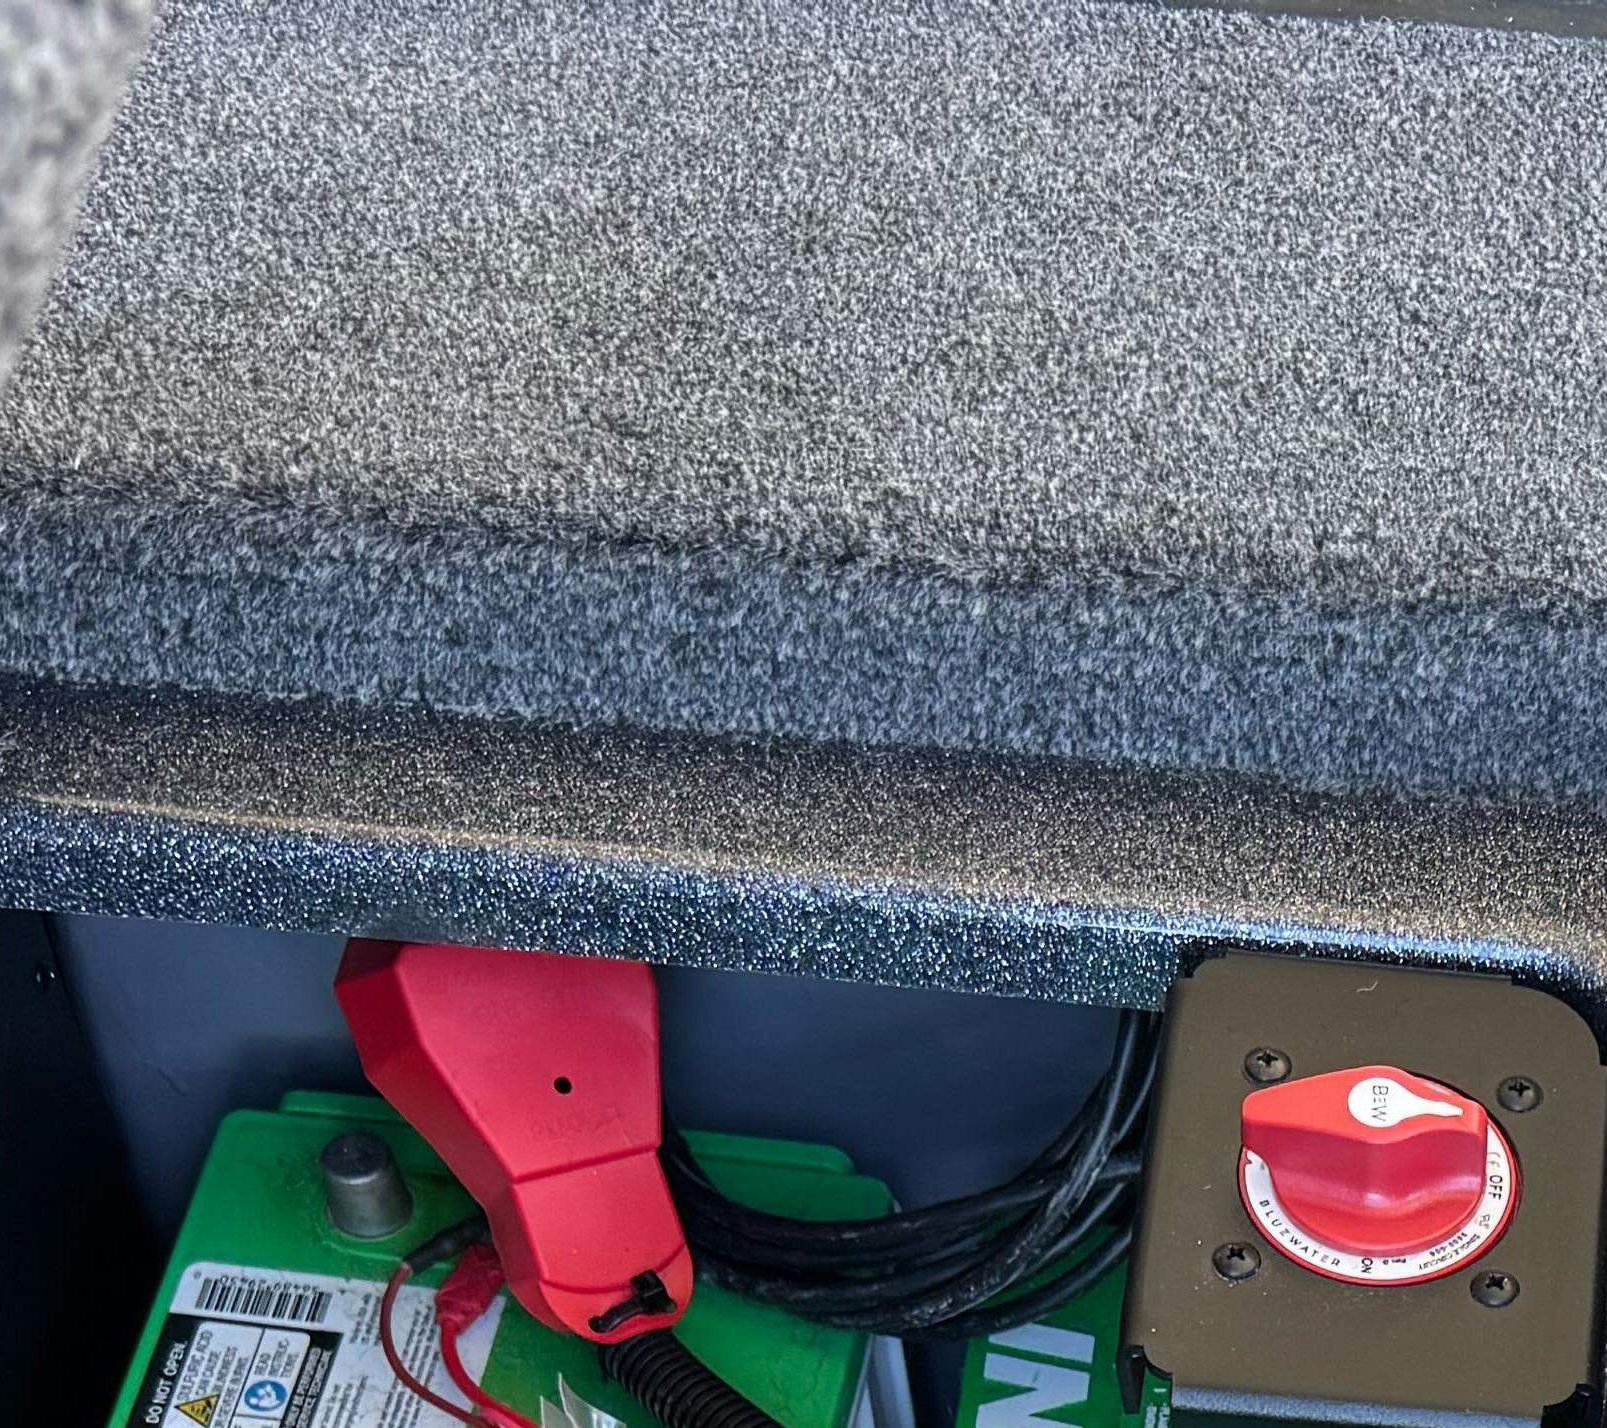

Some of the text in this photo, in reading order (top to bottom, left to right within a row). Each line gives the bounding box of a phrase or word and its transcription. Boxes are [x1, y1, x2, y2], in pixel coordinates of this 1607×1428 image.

[1488, 1174, 1502, 1200] OFF
[1360, 1257, 1373, 1273] ON
[152, 1378, 172, 1404] NOT
[145, 1406, 163, 1423] DO
